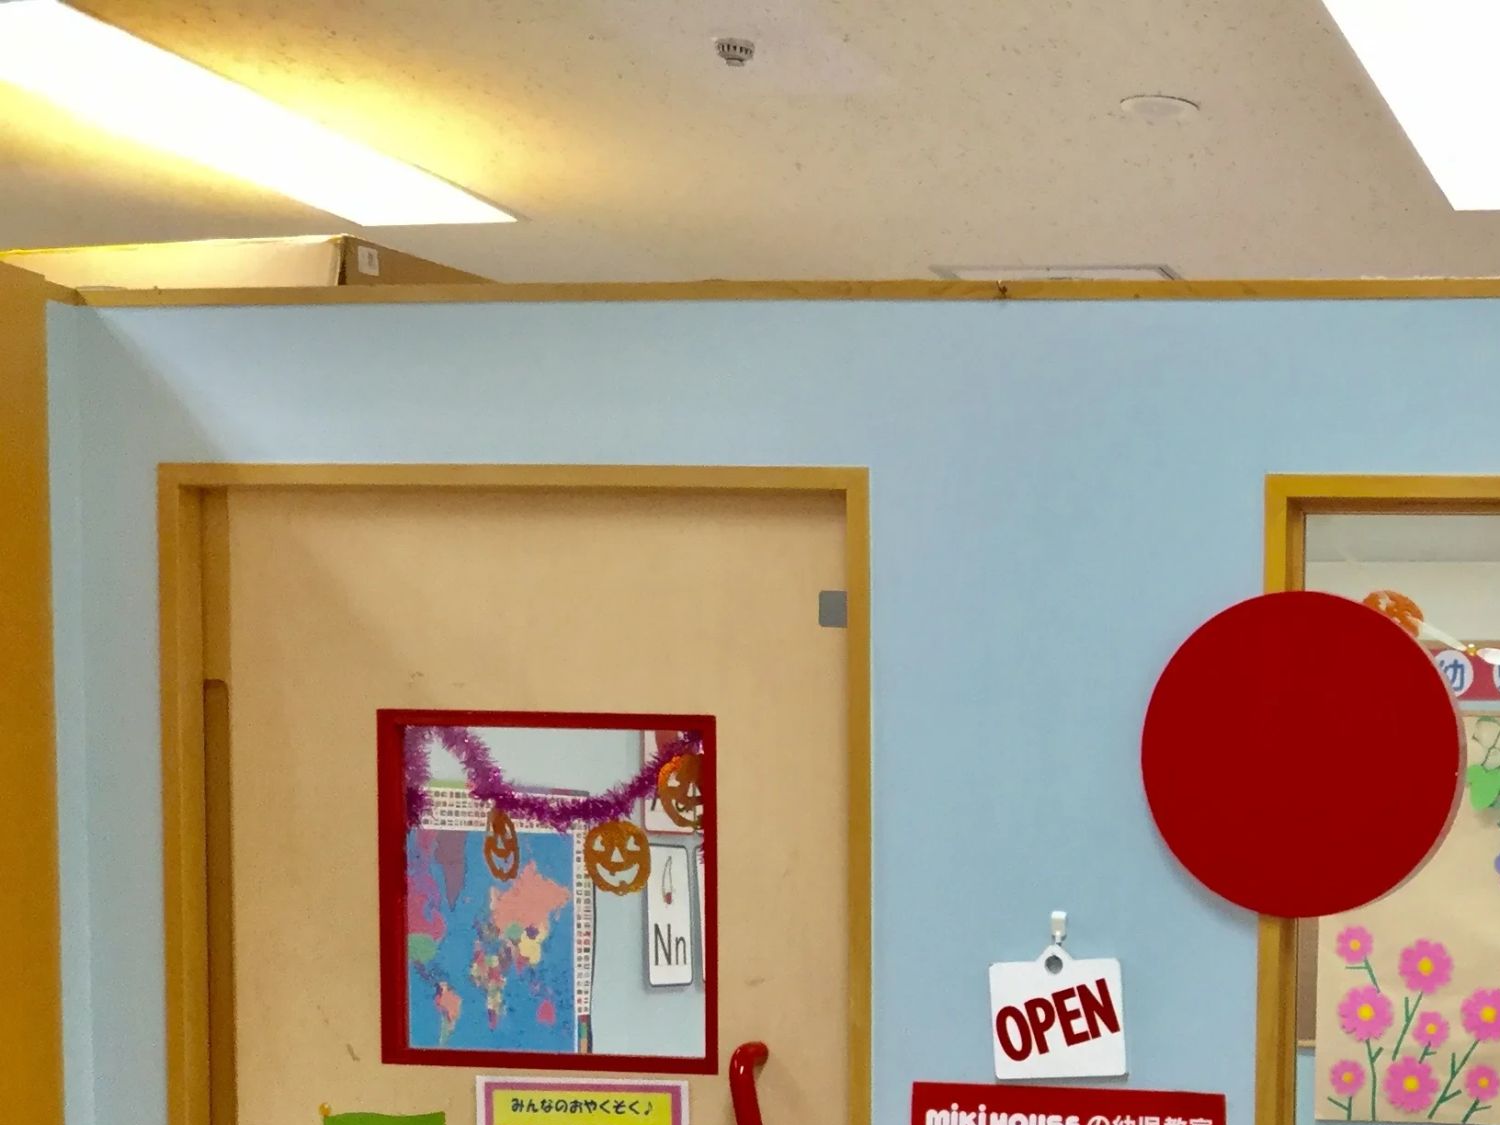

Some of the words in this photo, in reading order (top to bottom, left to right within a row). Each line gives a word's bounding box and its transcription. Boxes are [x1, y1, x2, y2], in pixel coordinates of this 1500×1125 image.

[653, 923, 687, 966] Nn
[996, 977, 1121, 1062] OPEN
[511, 1097, 640, 1115] みんなのおやくそく
